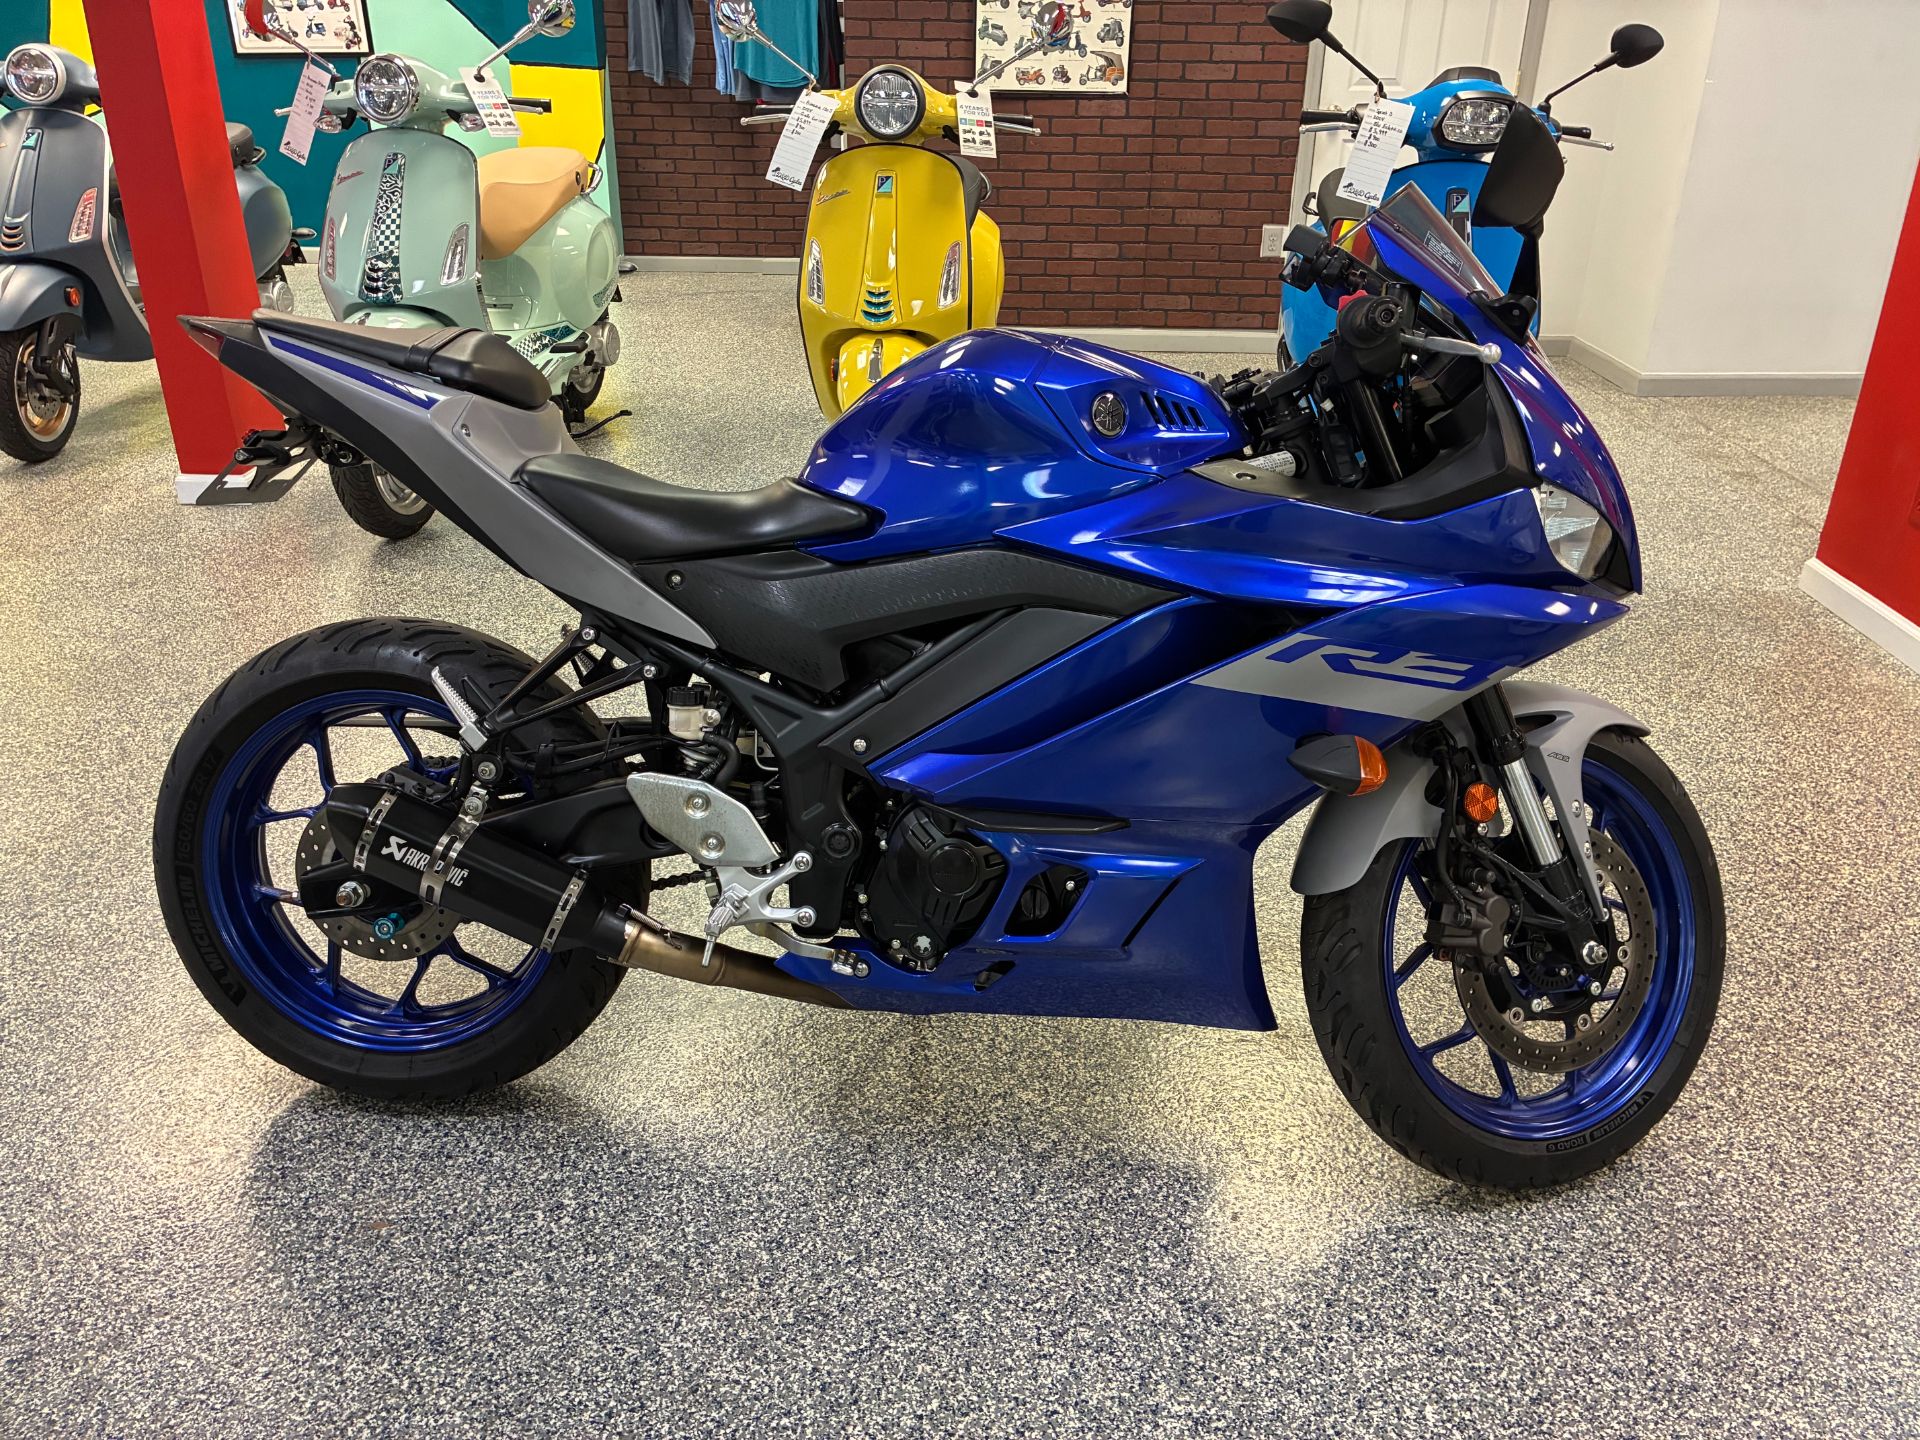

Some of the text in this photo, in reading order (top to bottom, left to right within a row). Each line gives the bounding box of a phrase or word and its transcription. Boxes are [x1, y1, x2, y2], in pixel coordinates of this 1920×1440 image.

[1453, 195, 1462, 206] P
[178, 873, 226, 971] MICHELIN
[1592, 1103, 1638, 1140] MICHELIN
[1557, 1136, 1585, 1150] ROAD
